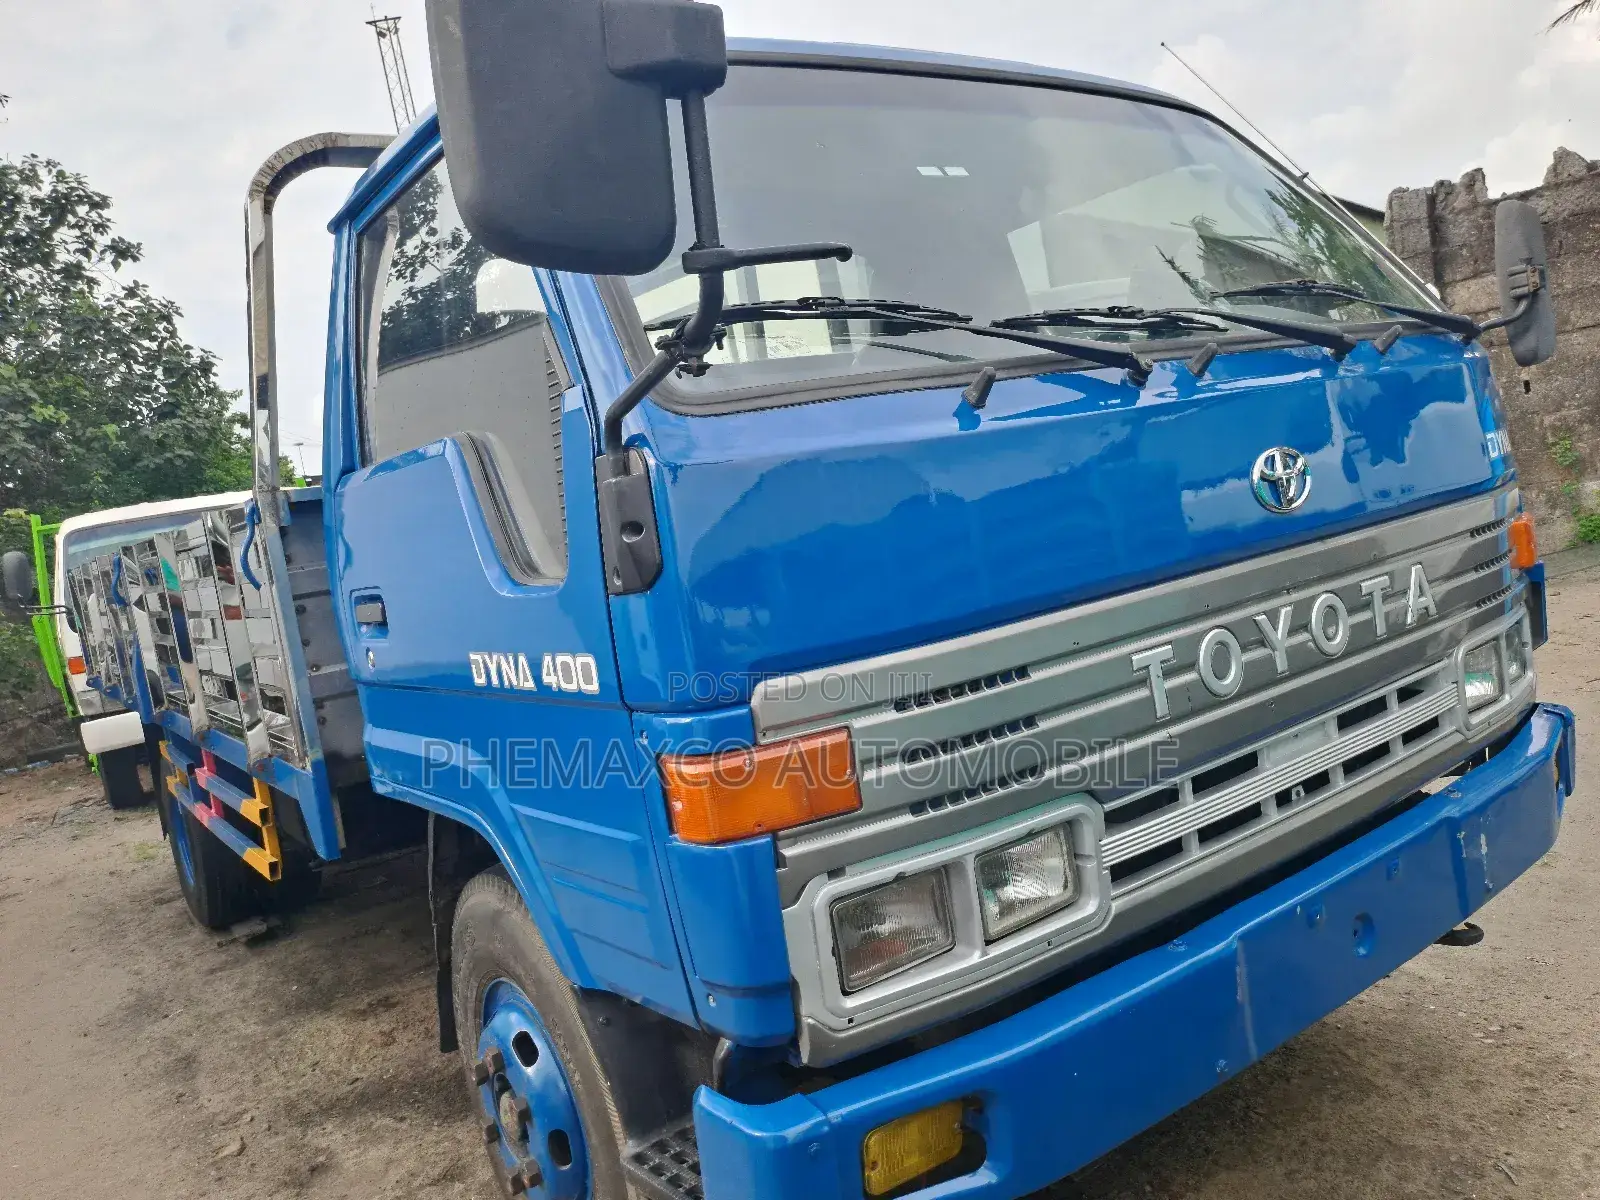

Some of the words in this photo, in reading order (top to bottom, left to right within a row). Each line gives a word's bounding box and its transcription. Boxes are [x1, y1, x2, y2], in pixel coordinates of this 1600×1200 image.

[469, 652, 537, 691] DYNA
[542, 653, 600, 694] 400
[1131, 562, 1438, 720] TOYOTA
